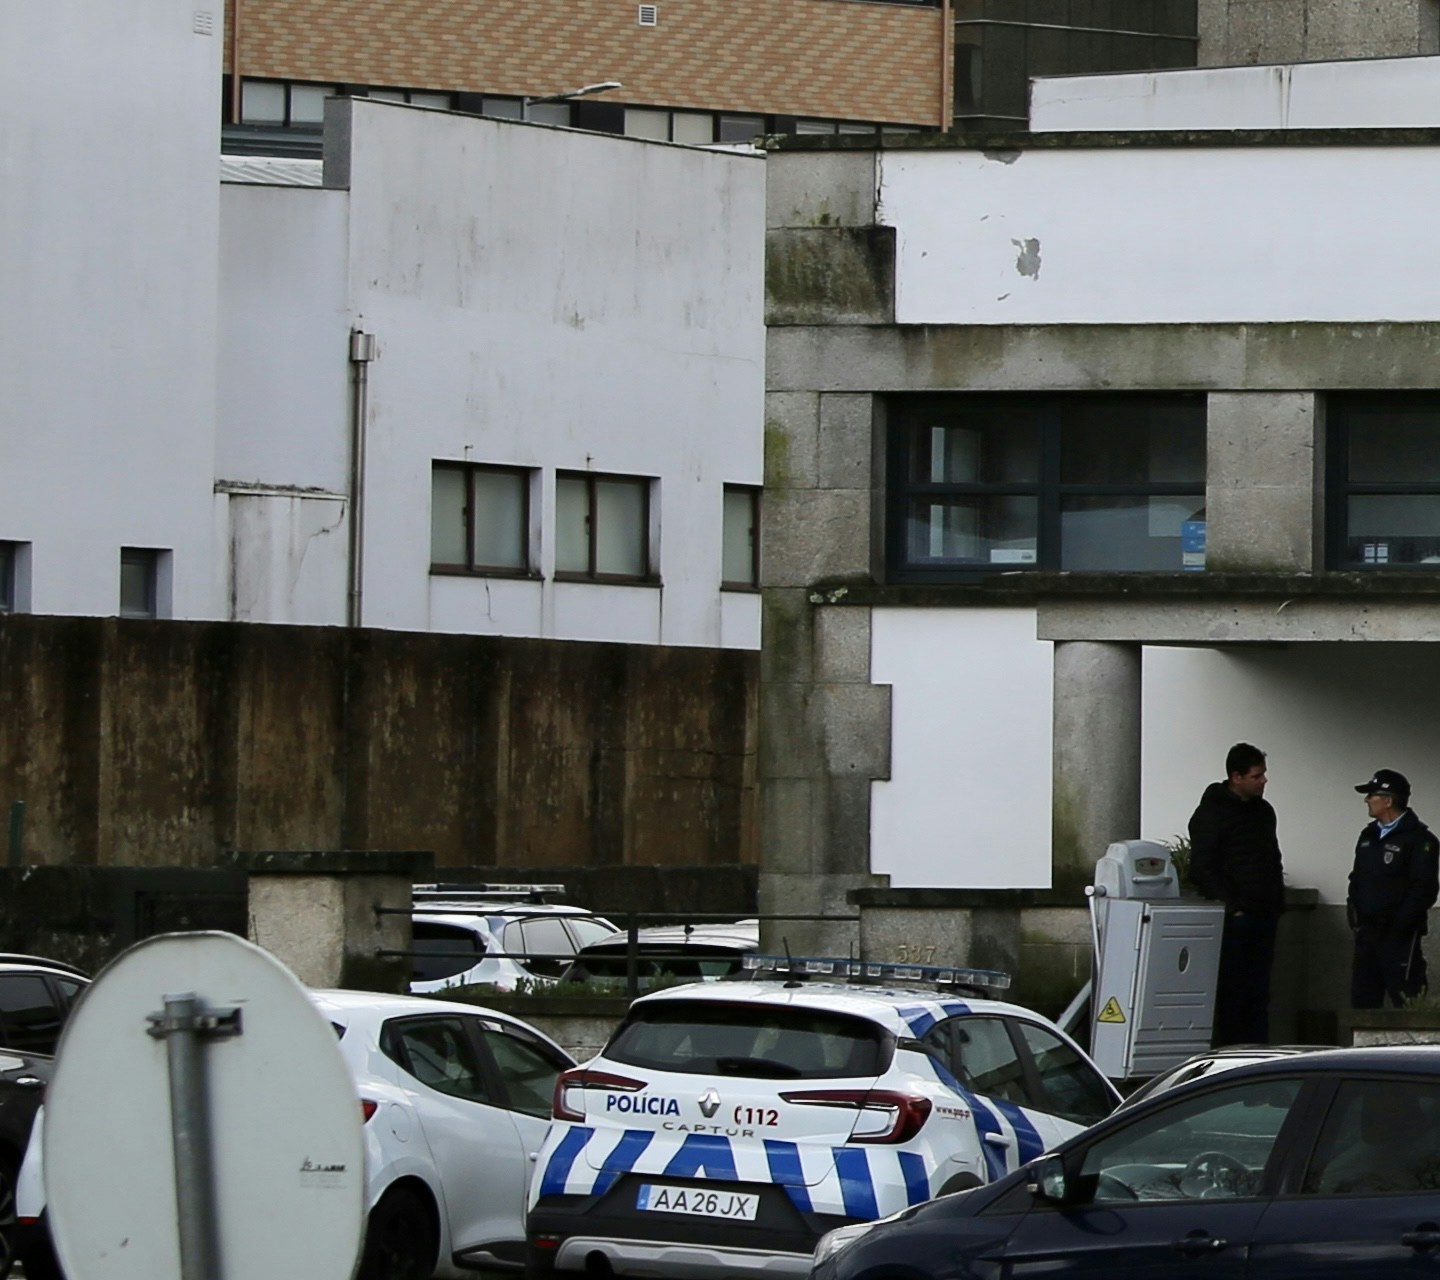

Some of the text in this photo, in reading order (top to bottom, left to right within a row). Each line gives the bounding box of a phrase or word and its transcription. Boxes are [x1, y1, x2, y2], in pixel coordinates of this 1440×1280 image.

[606, 1092, 779, 1127] POLÍCIA 112
[662, 1121, 755, 1138] CAPTUR
